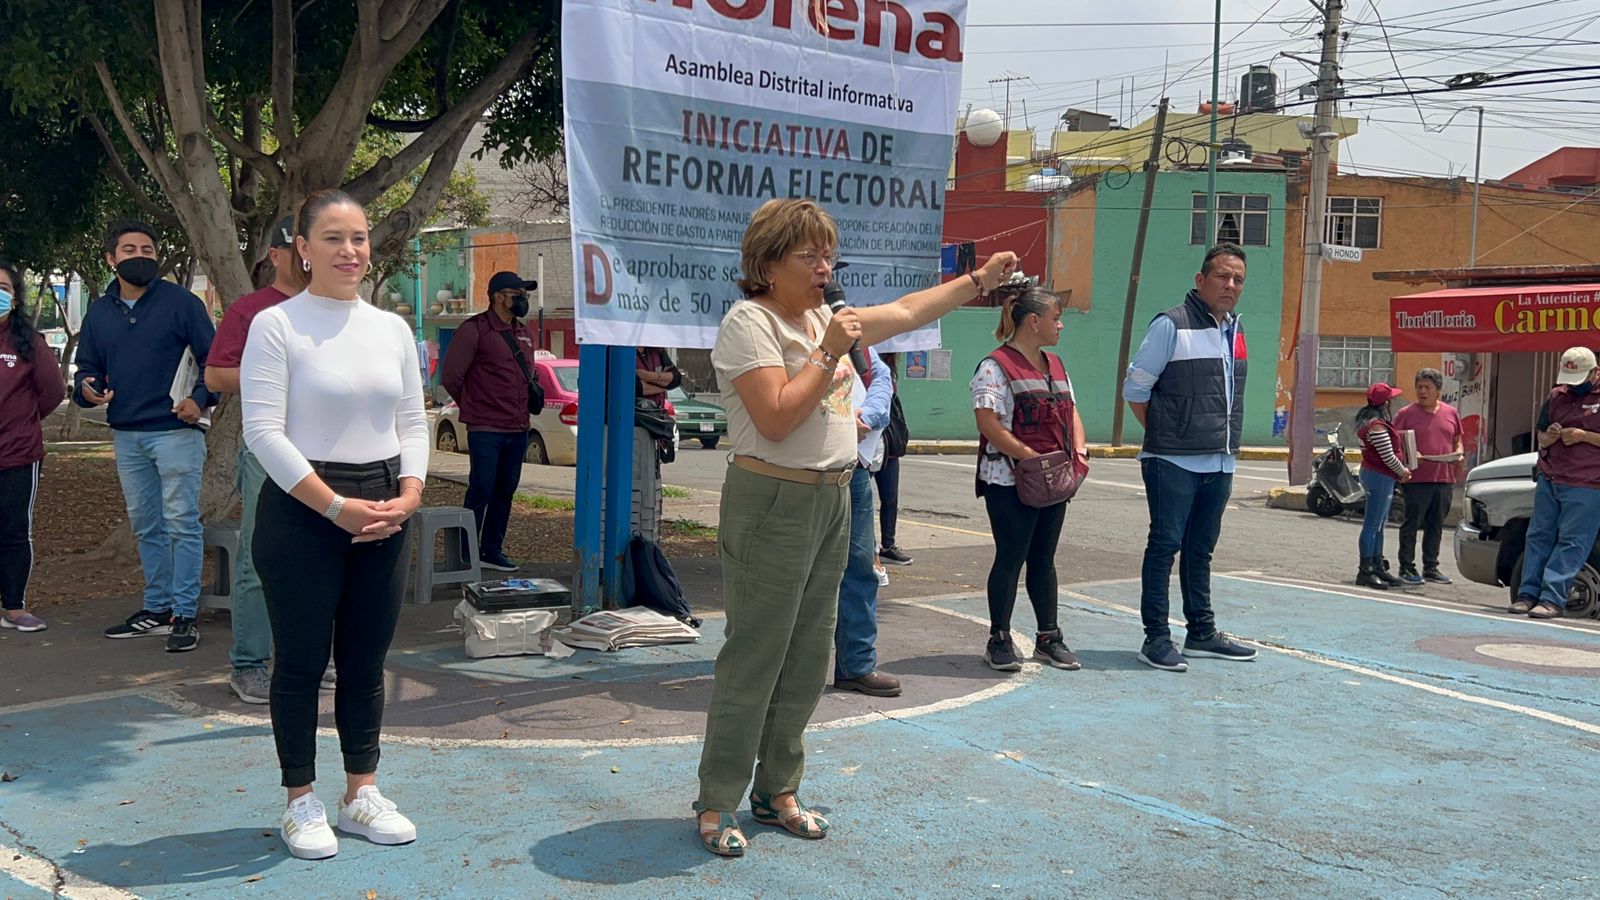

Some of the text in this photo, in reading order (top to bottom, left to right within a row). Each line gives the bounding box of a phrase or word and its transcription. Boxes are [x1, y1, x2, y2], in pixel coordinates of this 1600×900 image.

[665, 54, 914, 113] Asamblea Distrital informativa
[681, 109, 893, 166] INICIATIVA DE
[622, 146, 941, 210] REFORMA ELECTORAL
[600, 215, 659, 235] REDUCCIÓN
[661, 223, 674, 237] DE
[676, 227, 706, 240] GASTO
[707, 228, 715, 241] A
[716, 231, 743, 243] PARTI
[838, 235, 869, 249] NACIÓN
[871, 239, 882, 250] DE
[613, 197, 677, 217] PRESIDENTE
[679, 205, 717, 222] ANDRÉS
[718, 211, 751, 225] MANUE
[872, 220, 918, 234] CREACIÓN
[919, 223, 933, 235] DEL
[626, 254, 717, 283] aprobarse
[722, 266, 738, 282] se
[834, 268, 877, 288] tener
[1334, 249, 1359, 259] HONDO
[617, 287, 649, 312] más
[659, 288, 681, 313] de
[690, 293, 711, 315] 50
[1518, 294, 1532, 306] La
[1534, 292, 1590, 305] Autentica
[1395, 310, 1476, 329] Tortilleria
